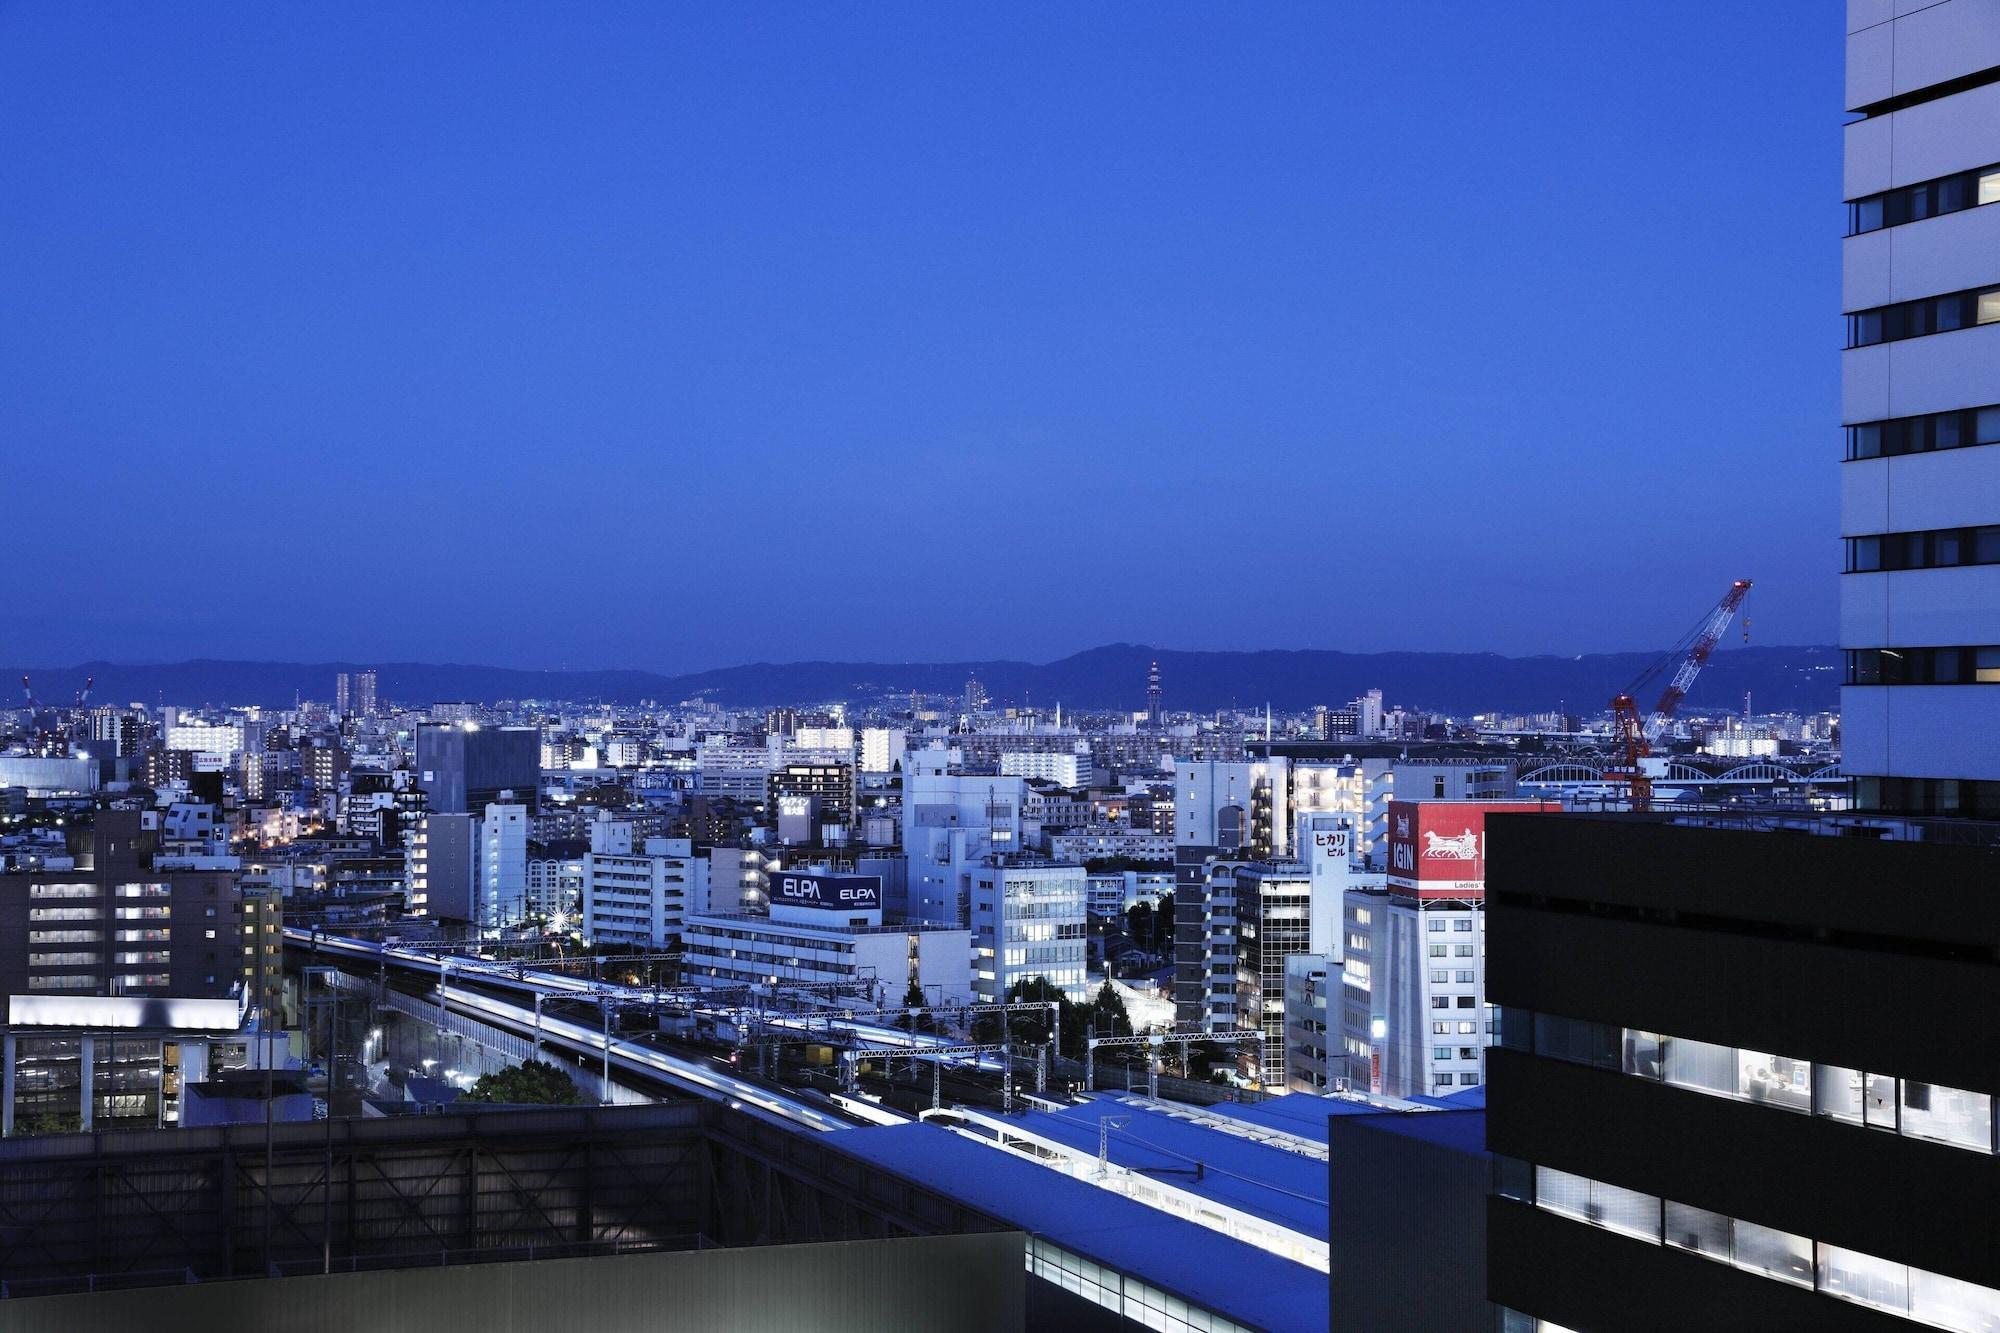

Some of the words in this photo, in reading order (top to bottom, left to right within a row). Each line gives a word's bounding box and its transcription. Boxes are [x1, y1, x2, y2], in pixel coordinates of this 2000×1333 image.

[1316, 834, 1345, 847] ヒカリ
[1328, 848, 1345, 857] ビル
[1393, 842, 1414, 870] IGIN
[783, 878, 821, 899] ELPA
[840, 889, 876, 900] ELPA
